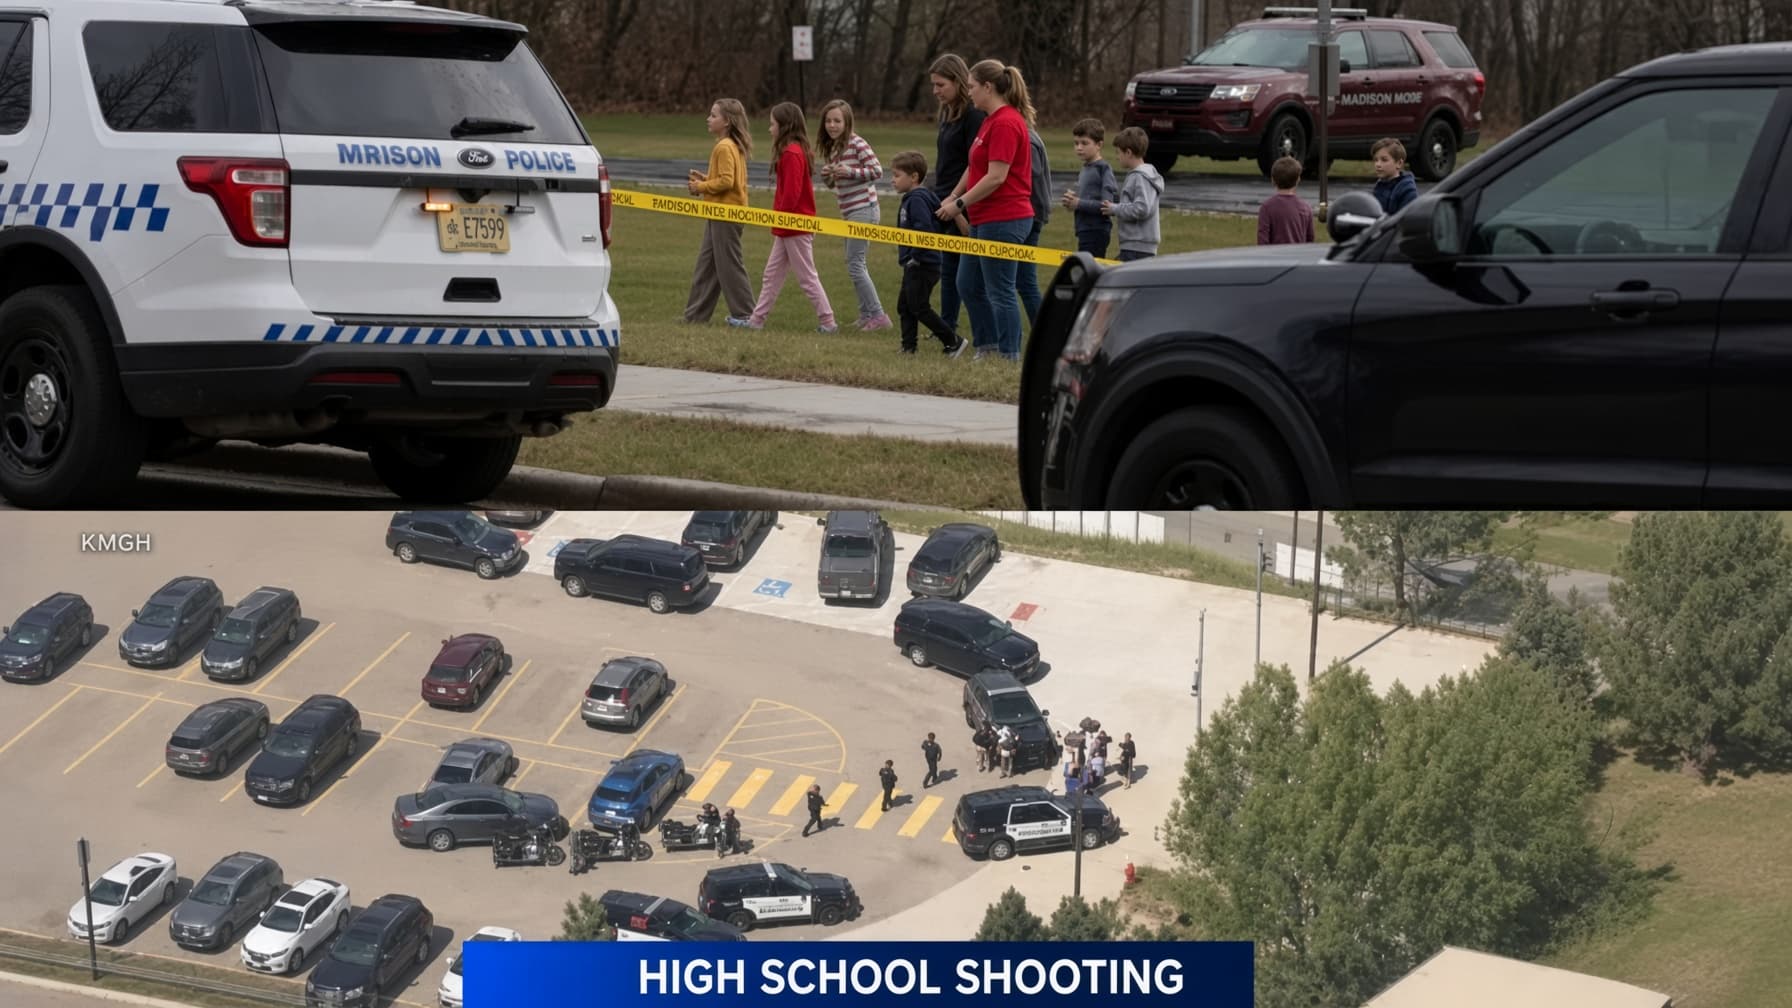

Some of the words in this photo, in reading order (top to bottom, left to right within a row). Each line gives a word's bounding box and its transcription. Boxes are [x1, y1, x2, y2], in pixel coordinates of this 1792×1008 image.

[1341, 93, 1392, 105] MADISON
[336, 143, 442, 168] MRISON
[504, 149, 577, 174] POLICE
[463, 217, 505, 240] E7599
